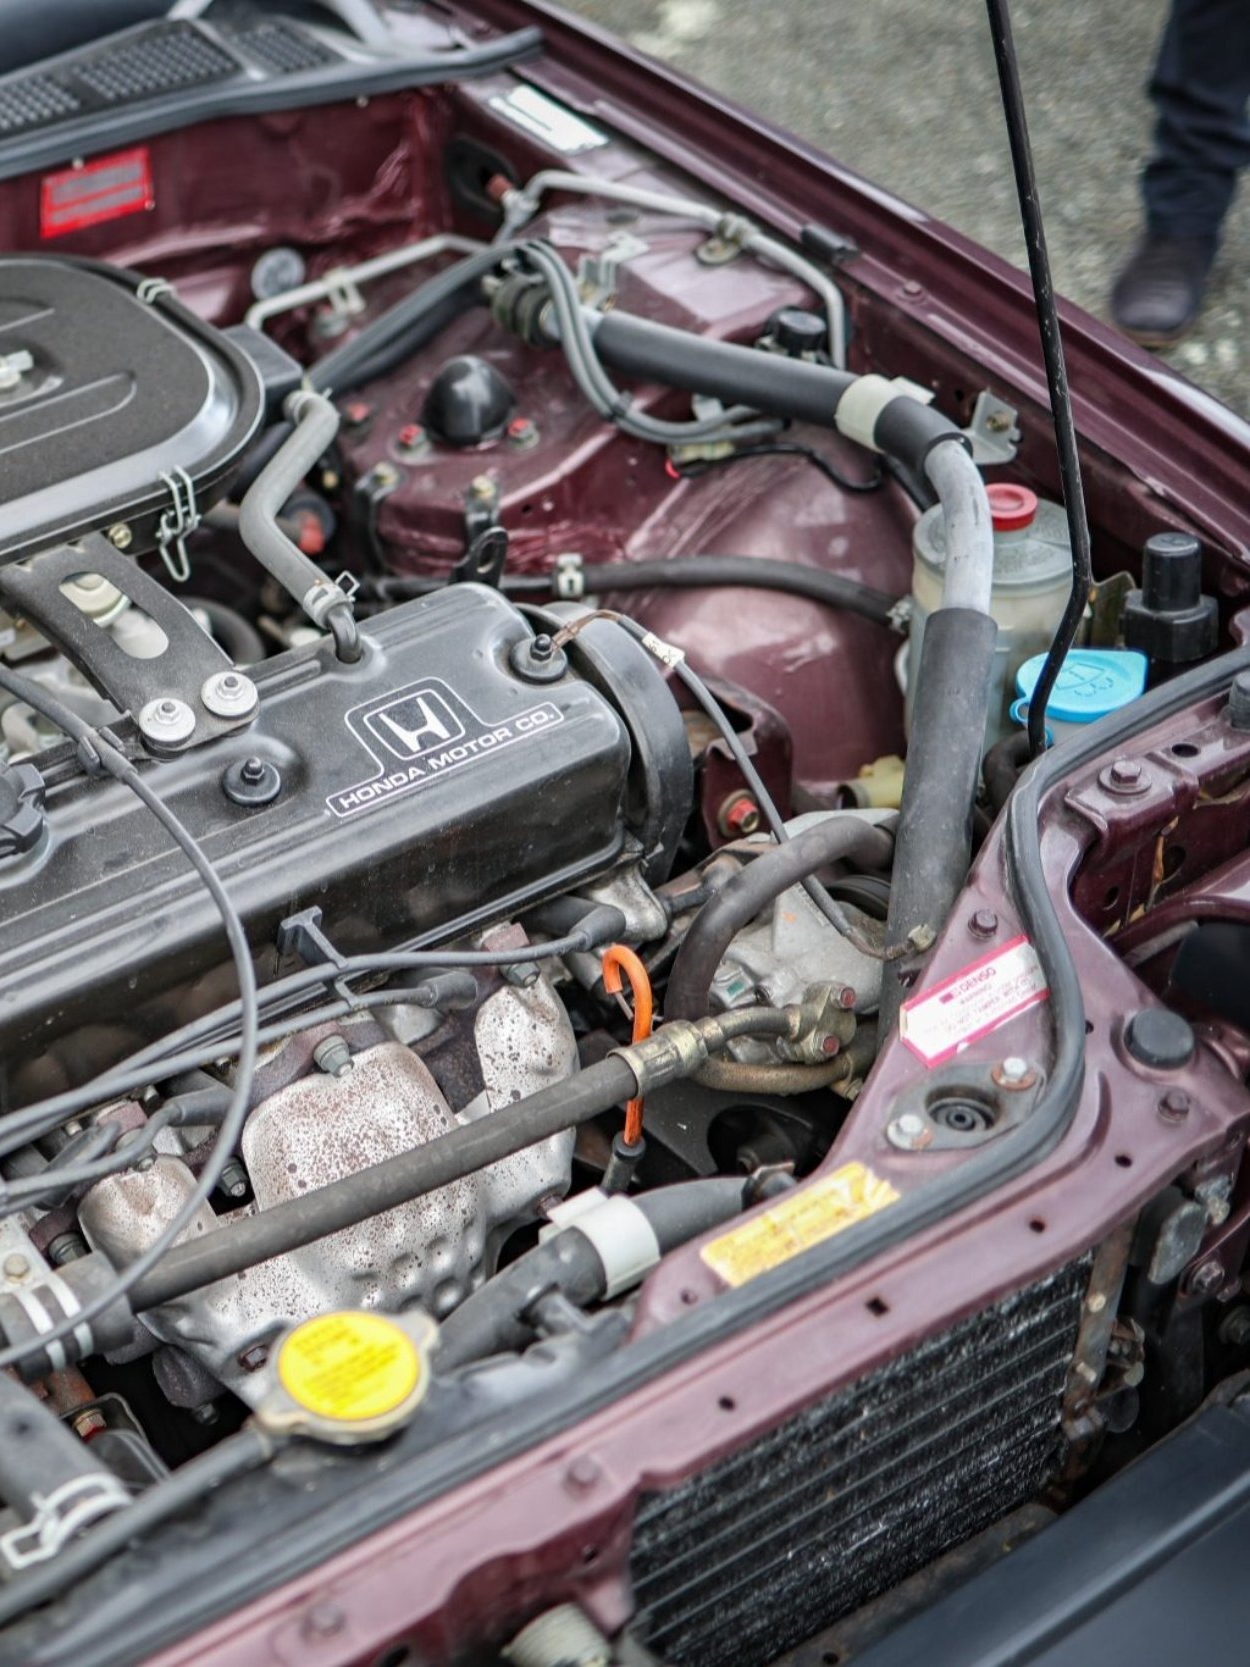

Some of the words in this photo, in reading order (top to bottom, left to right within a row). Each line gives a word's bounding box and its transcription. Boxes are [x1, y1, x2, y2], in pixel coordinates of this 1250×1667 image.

[338, 766, 426, 807] HONDA
[429, 726, 513, 769] MOTOR
[515, 709, 555, 732] CO.
[961, 966, 997, 992] DENSO
